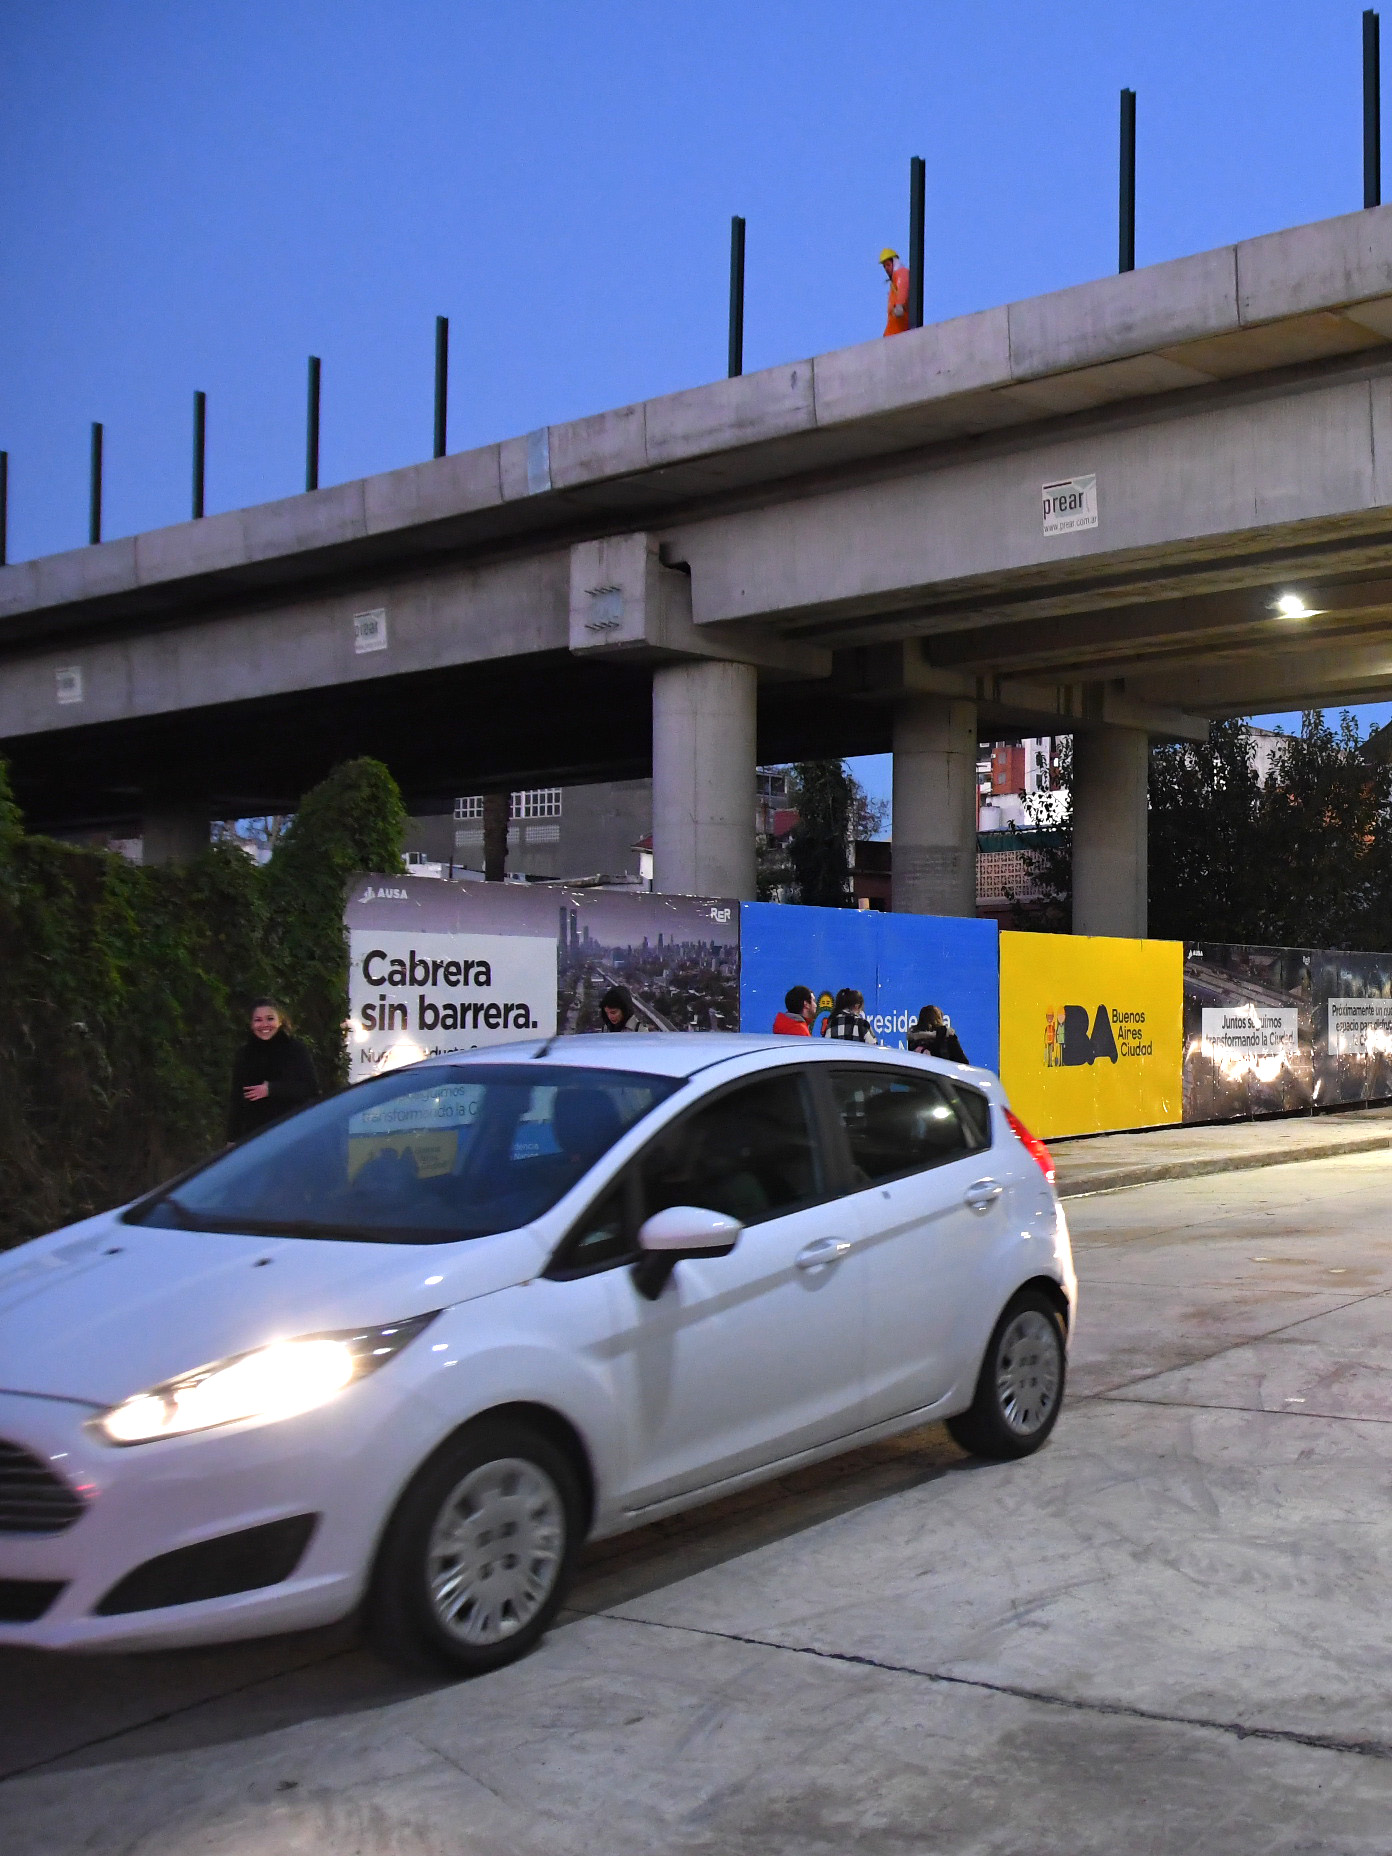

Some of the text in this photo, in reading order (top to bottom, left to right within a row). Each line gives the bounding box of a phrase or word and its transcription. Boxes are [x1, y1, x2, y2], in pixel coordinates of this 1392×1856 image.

[1043, 492, 1084, 520] prear
[377, 888, 408, 899] AUSA
[710, 907, 731, 922] RER
[362, 949, 492, 987] Cabrera
[361, 994, 538, 1031] sin barrera.
[1111, 1008, 1145, 1023] Buenos
[1221, 1014, 1246, 1029] Juntos
[1117, 1025, 1142, 1040] Aires
[1261, 1032, 1268, 1046] la
[1120, 1041, 1153, 1056] Ciudad
